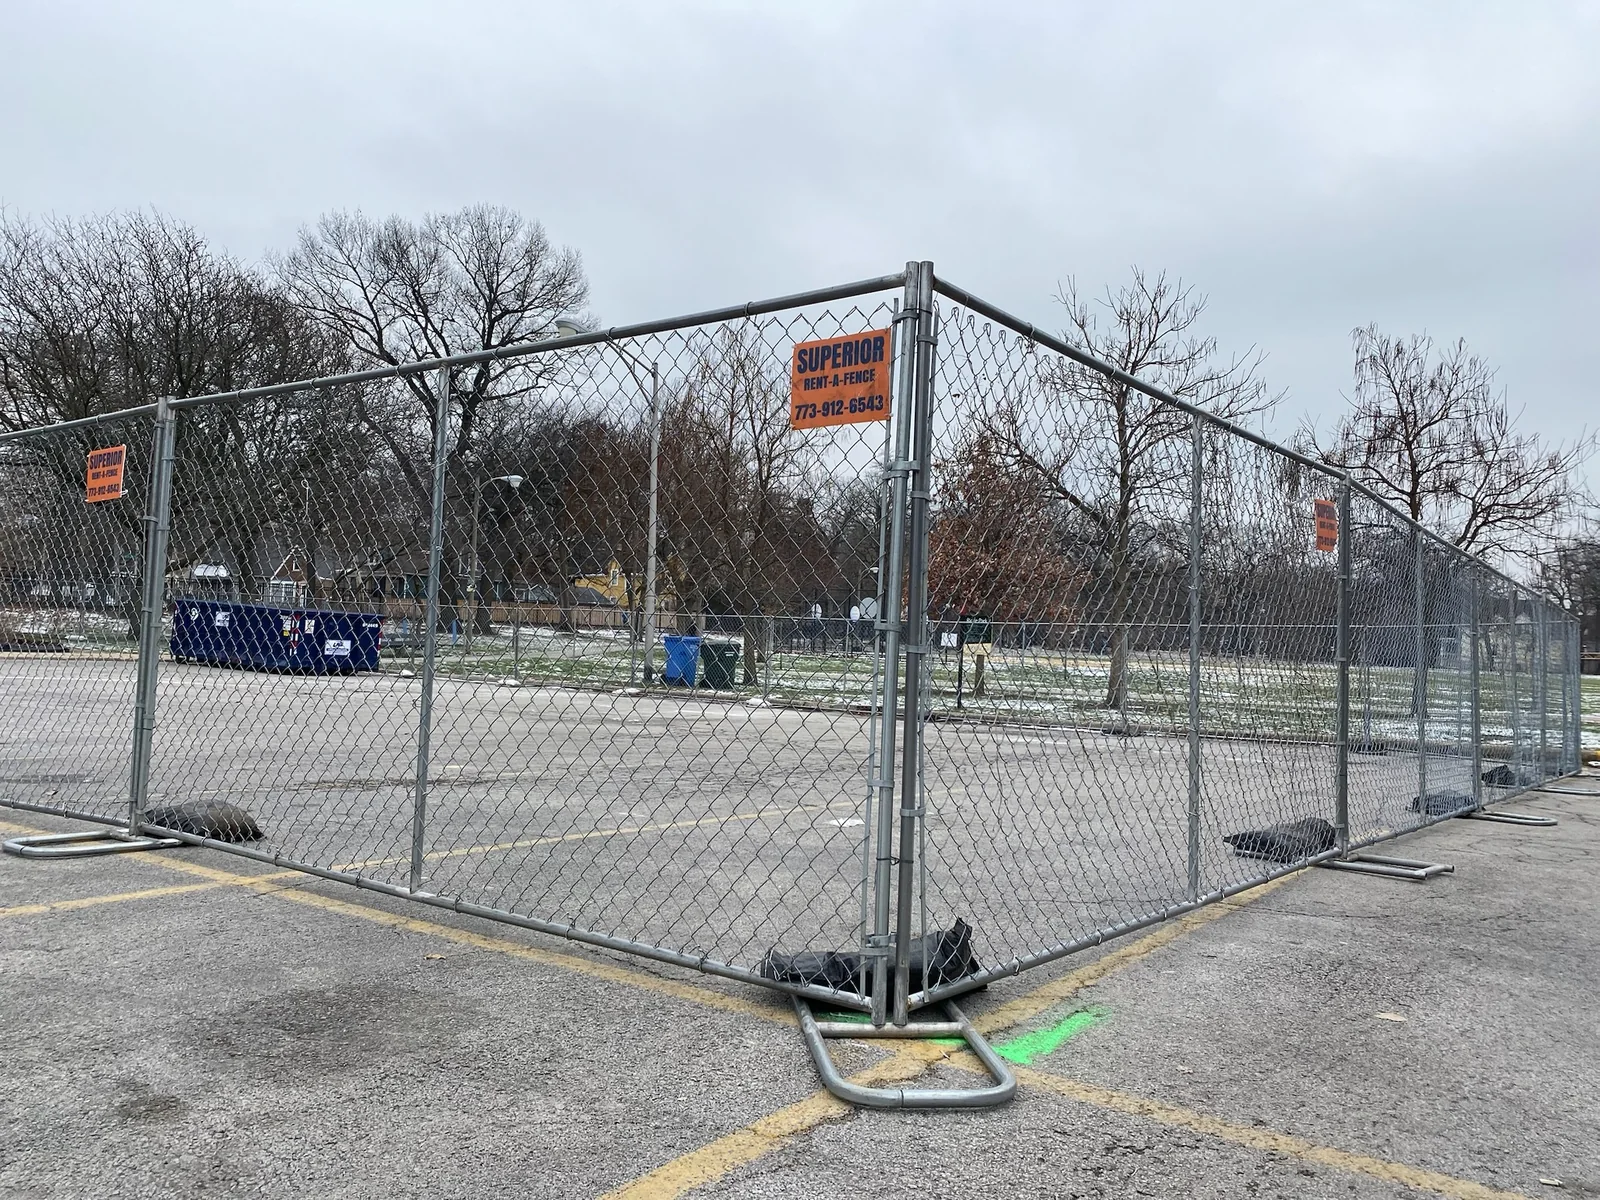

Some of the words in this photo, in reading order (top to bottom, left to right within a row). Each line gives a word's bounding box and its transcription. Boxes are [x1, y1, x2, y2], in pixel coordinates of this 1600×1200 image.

[797, 336, 885, 374] SUPERIOR
[803, 368, 876, 391] RENT-A-FENCE
[795, 395, 884, 420] 773-912-6543
[89, 450, 123, 470] SUPERIOR
